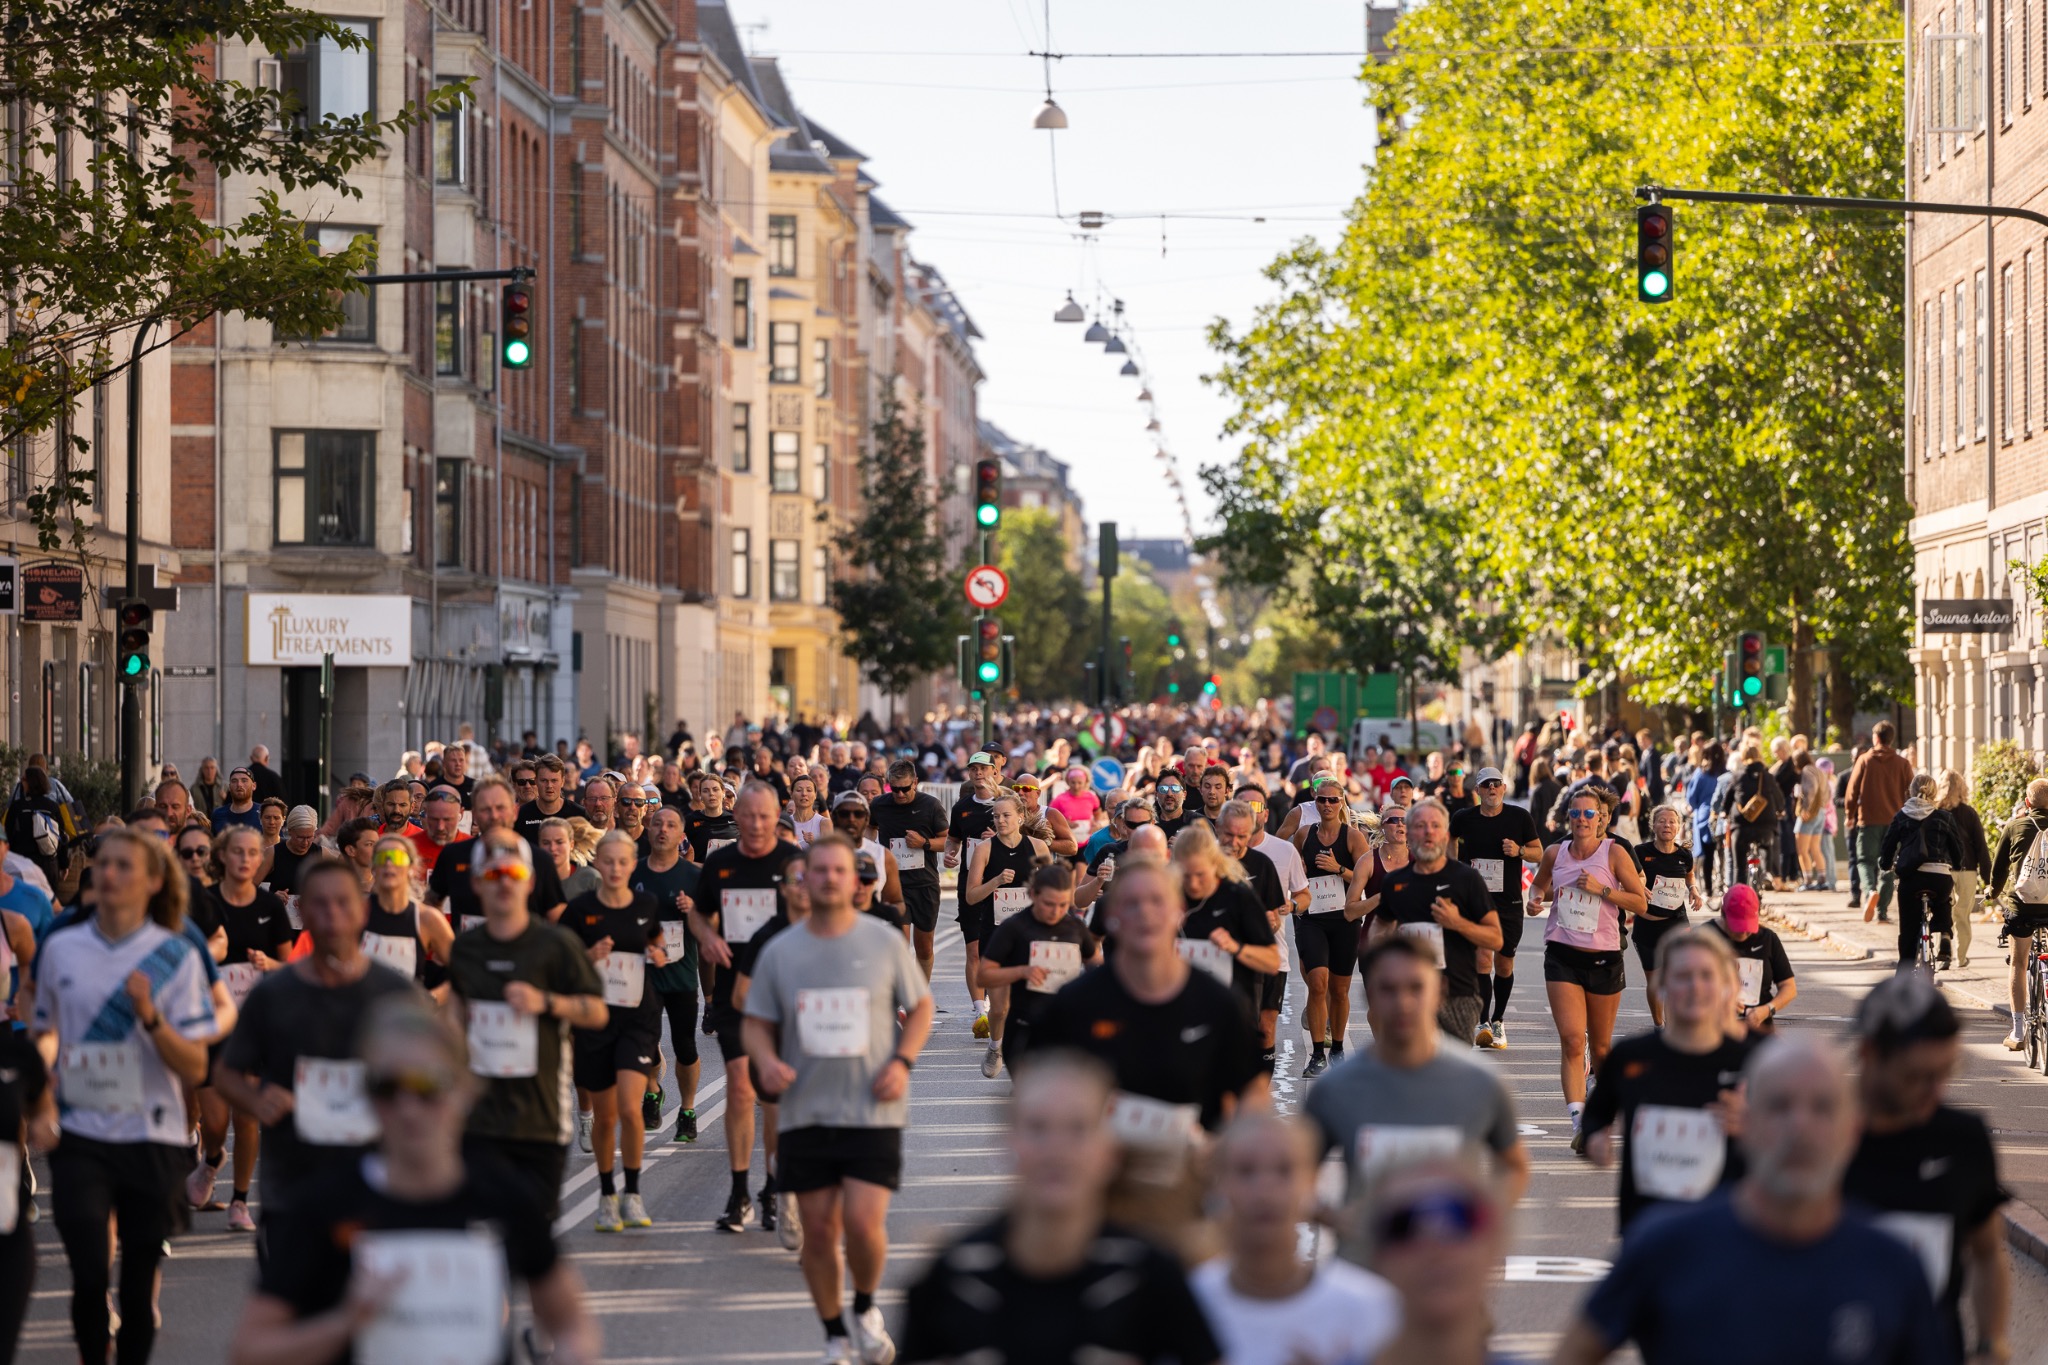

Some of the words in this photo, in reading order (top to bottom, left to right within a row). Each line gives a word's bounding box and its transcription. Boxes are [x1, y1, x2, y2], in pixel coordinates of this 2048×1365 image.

[26, 568, 81, 577] HOMELAND
[1972, 610, 2011, 625] salon
[284, 617, 349, 634] LUXURY
[284, 637, 393, 656] TREATMENTS
[1569, 908, 1585, 917] Lene
